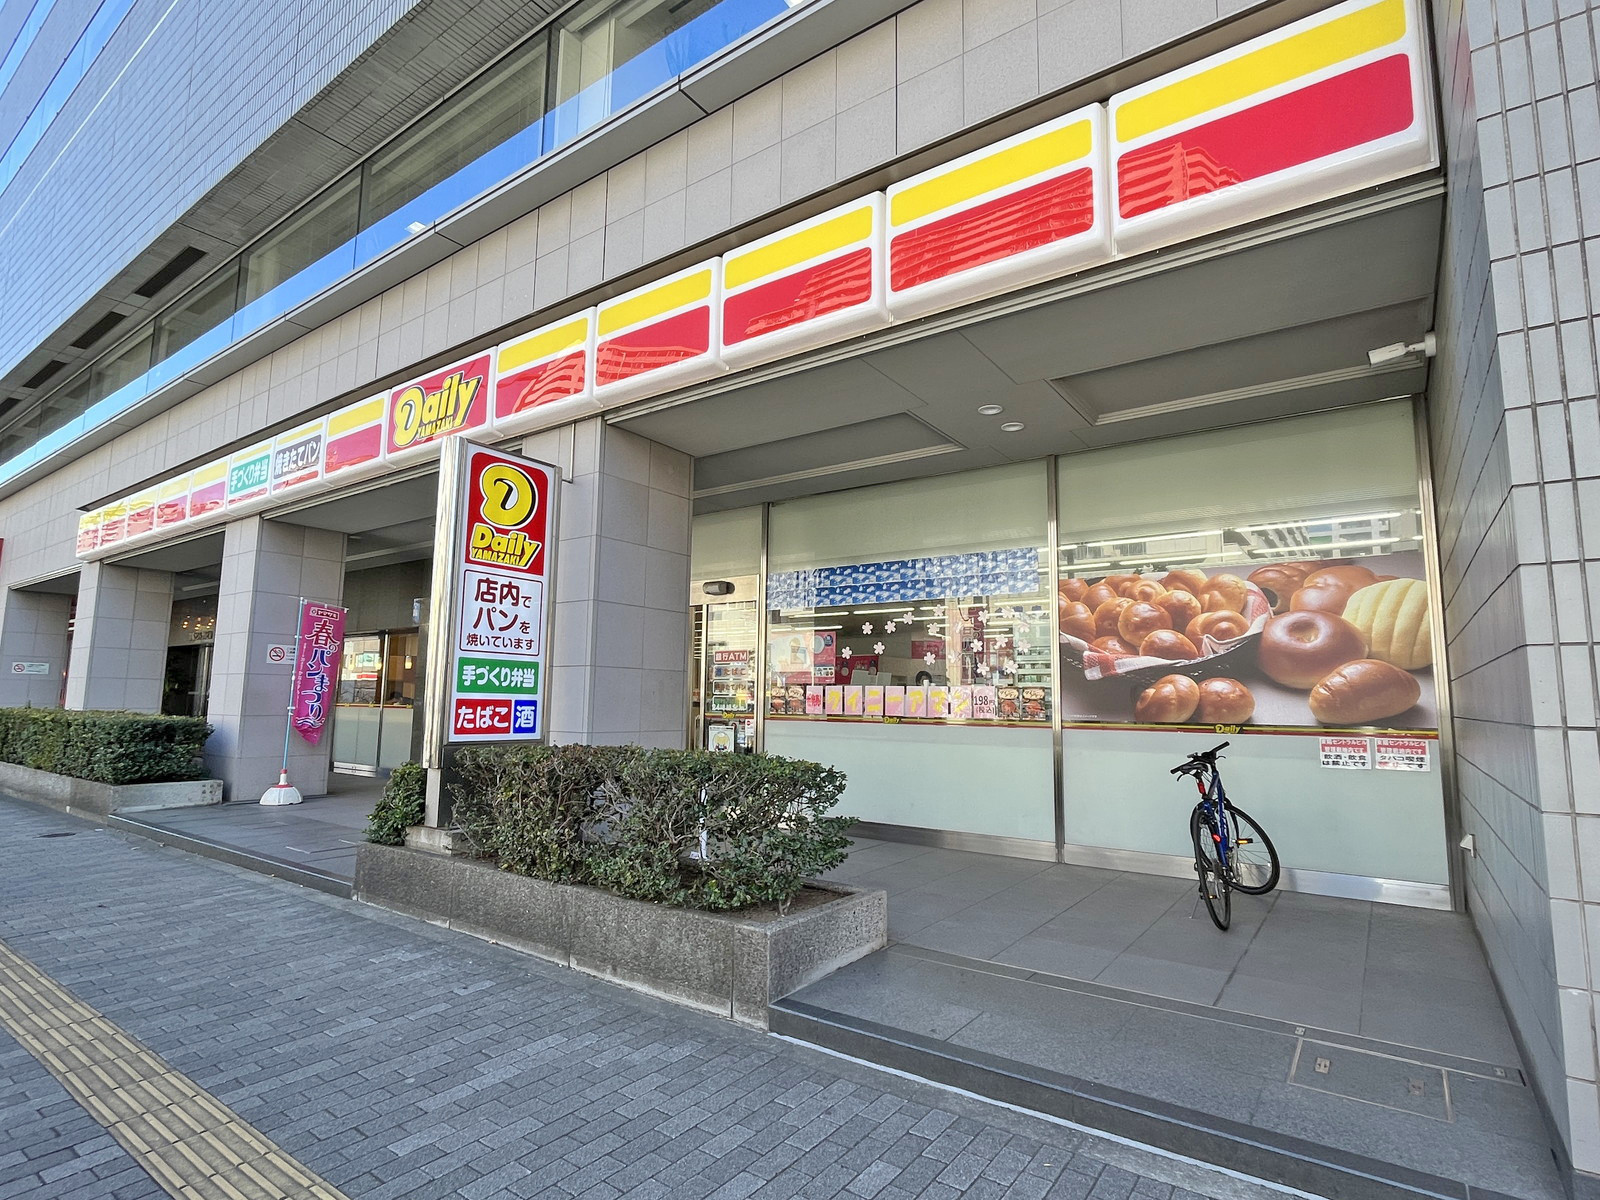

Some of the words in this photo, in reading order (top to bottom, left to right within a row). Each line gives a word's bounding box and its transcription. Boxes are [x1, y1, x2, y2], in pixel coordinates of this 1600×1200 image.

[394, 371, 483, 447] Daily
[417, 414, 455, 439] YAMAZAKI
[275, 441, 320, 475] 焼きたてパン
[231, 459, 268, 491] 手づくり弁当
[470, 546, 521, 566] YAMAZAKI
[472, 523, 542, 570] Daily
[474, 578, 531, 609] 店内で
[472, 606, 531, 634] パンを
[465, 633, 535, 652] 焼いています
[715, 652, 747, 661] 銀行ATM
[301, 619, 340, 721] 春のパンまつり
[461, 664, 536, 690] 手づくり弁当
[724, 667, 747, 676] たばこ
[827, 688, 970, 714] クイニーアマン
[974, 696, 996, 706] 198円
[456, 705, 511, 730] たばこ
[515, 705, 534, 728] 酒
[1214, 724, 1241, 734] Daily
